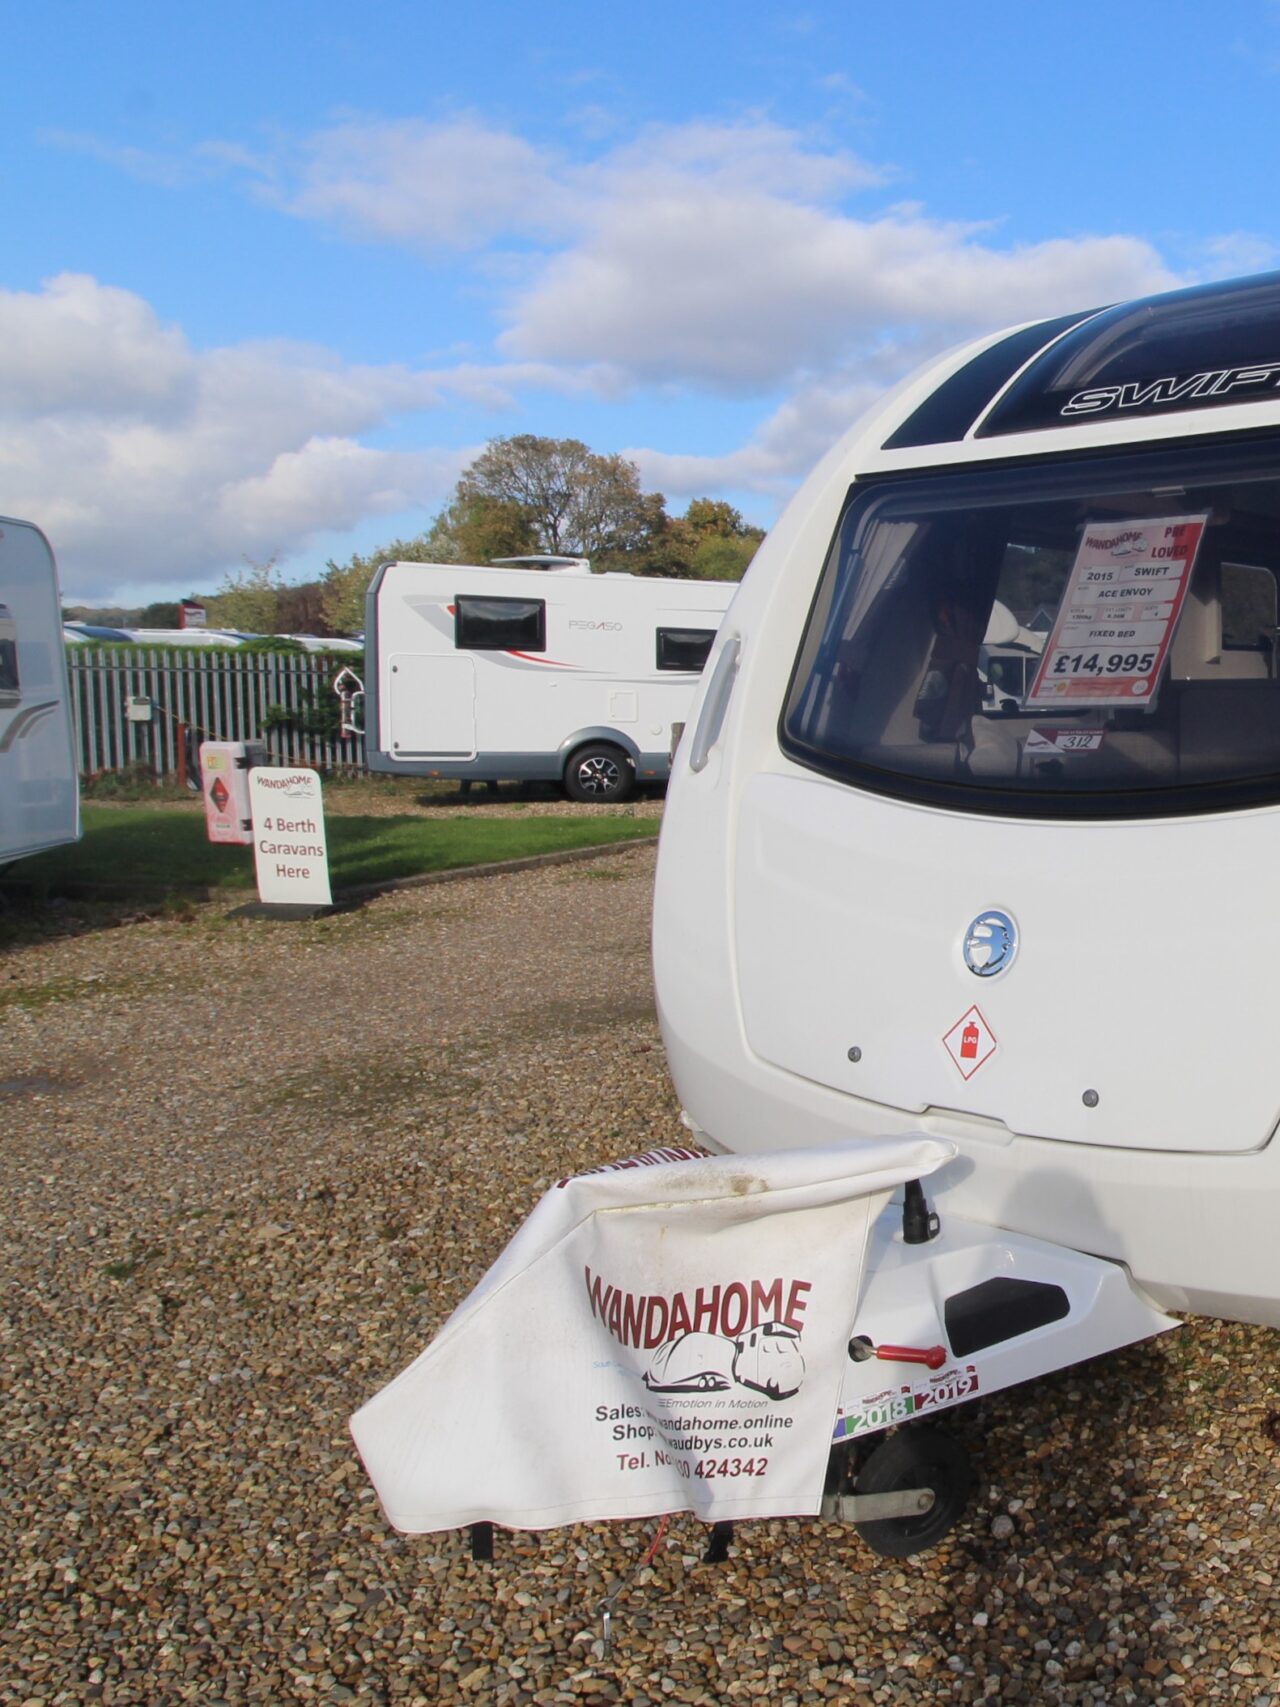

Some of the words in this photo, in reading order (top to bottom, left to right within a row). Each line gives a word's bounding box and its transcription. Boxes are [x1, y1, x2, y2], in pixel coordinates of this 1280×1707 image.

[1164, 526, 1186, 539] PRE
[1084, 531, 1143, 550] WANDAHOME
[1151, 545, 1188, 559] LOVED
[1087, 572, 1114, 581] 2015
[1134, 566, 1170, 577] SWIFT
[1098, 589, 1119, 599] ACE
[1120, 587, 1153, 598] ENVOY
[568, 620, 623, 632] PEGASO
[1088, 630, 1115, 638] FIXED
[1117, 630, 1136, 638] BED
[1053, 653, 1155, 677] £14,995
[1064, 735, 1093, 748] 312
[257, 775, 313, 790] WANDAHOME
[264, 817, 273, 831] 4
[277, 817, 316, 833] Berth
[260, 840, 324, 857] Caravans
[276, 863, 310, 879] Here
[963, 1036, 977, 1044] LPG
[585, 1265, 812, 1350] WANDAHOME
[921, 1376, 972, 1409] 2019
[660, 1398, 711, 1409] Emotion
[714, 1399, 725, 1409] in
[728, 1399, 768, 1409] Motion
[853, 1399, 907, 1434] 2018
[616, 1452, 650, 1471] Tel.
[694, 1457, 769, 1479] 424342
